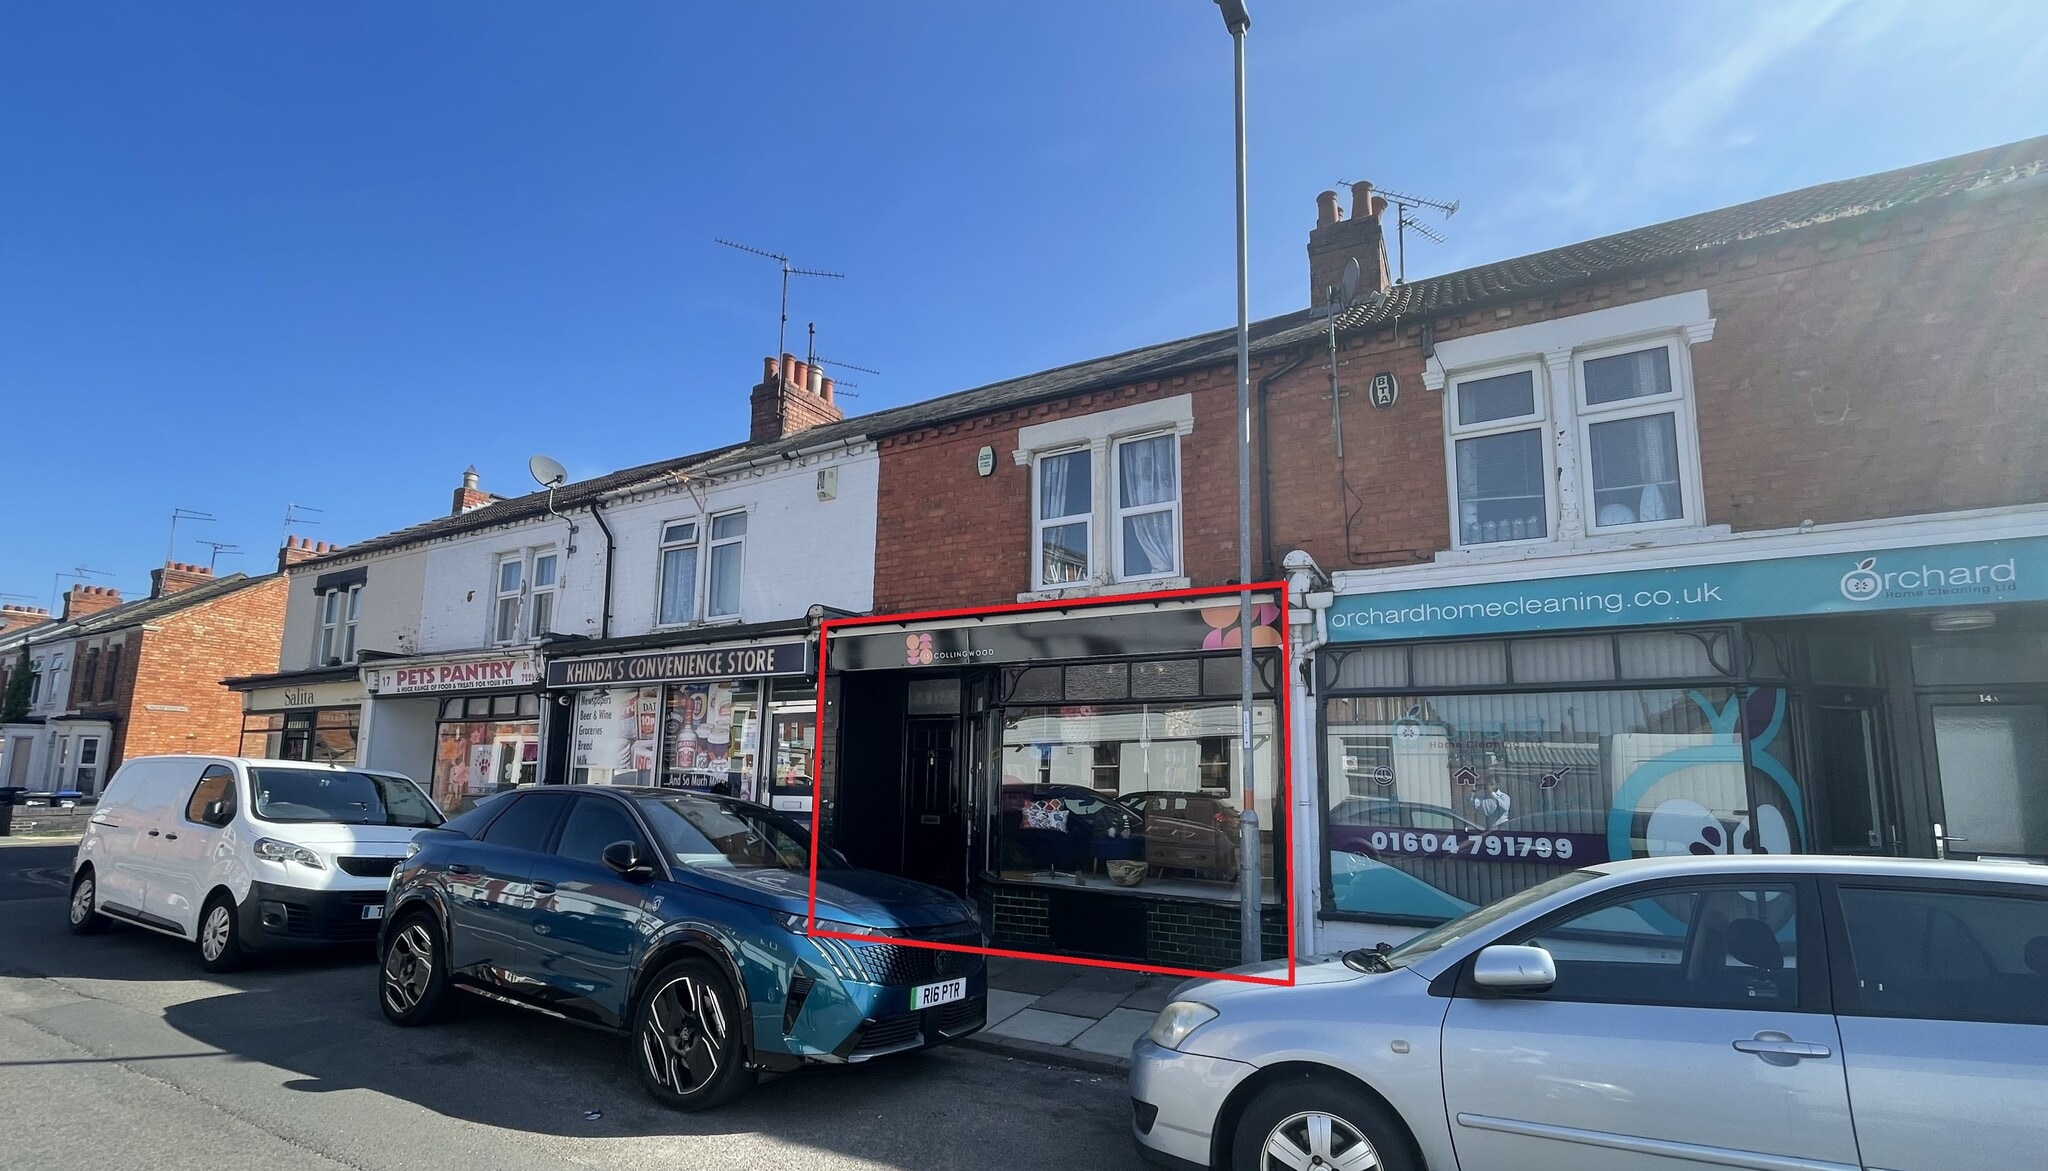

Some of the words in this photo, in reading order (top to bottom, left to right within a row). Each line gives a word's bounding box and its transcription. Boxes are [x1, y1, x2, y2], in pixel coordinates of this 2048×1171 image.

[1378, 377, 1389, 403] BTA
[1840, 557, 2016, 601] Orchard
[1886, 590, 1924, 599] Home
[1928, 585, 1990, 596] Cleaning
[1332, 582, 1722, 628] orchardhomecleaning.co.uk
[934, 649, 994, 659] COLLINGWOOD
[396, 667, 435, 686] PETS
[440, 661, 515, 683] PANTRY
[566, 660, 624, 682] KHINDA'S
[628, 653, 722, 678] CONVENIENCE
[728, 649, 775, 673] STORE
[382, 676, 391, 687] 17
[285, 688, 314, 706] Salita
[580, 710, 592, 720] Beer
[599, 709, 612, 719] Wine
[579, 725, 602, 735] Groceries
[578, 739, 593, 750] Bread
[683, 774, 690, 785] So
[691, 774, 707, 786] Much
[1371, 831, 1459, 854] 01604
[1468, 835, 1573, 859] 791799
[923, 986, 940, 1005] R16
[942, 981, 960, 1001] PTR
